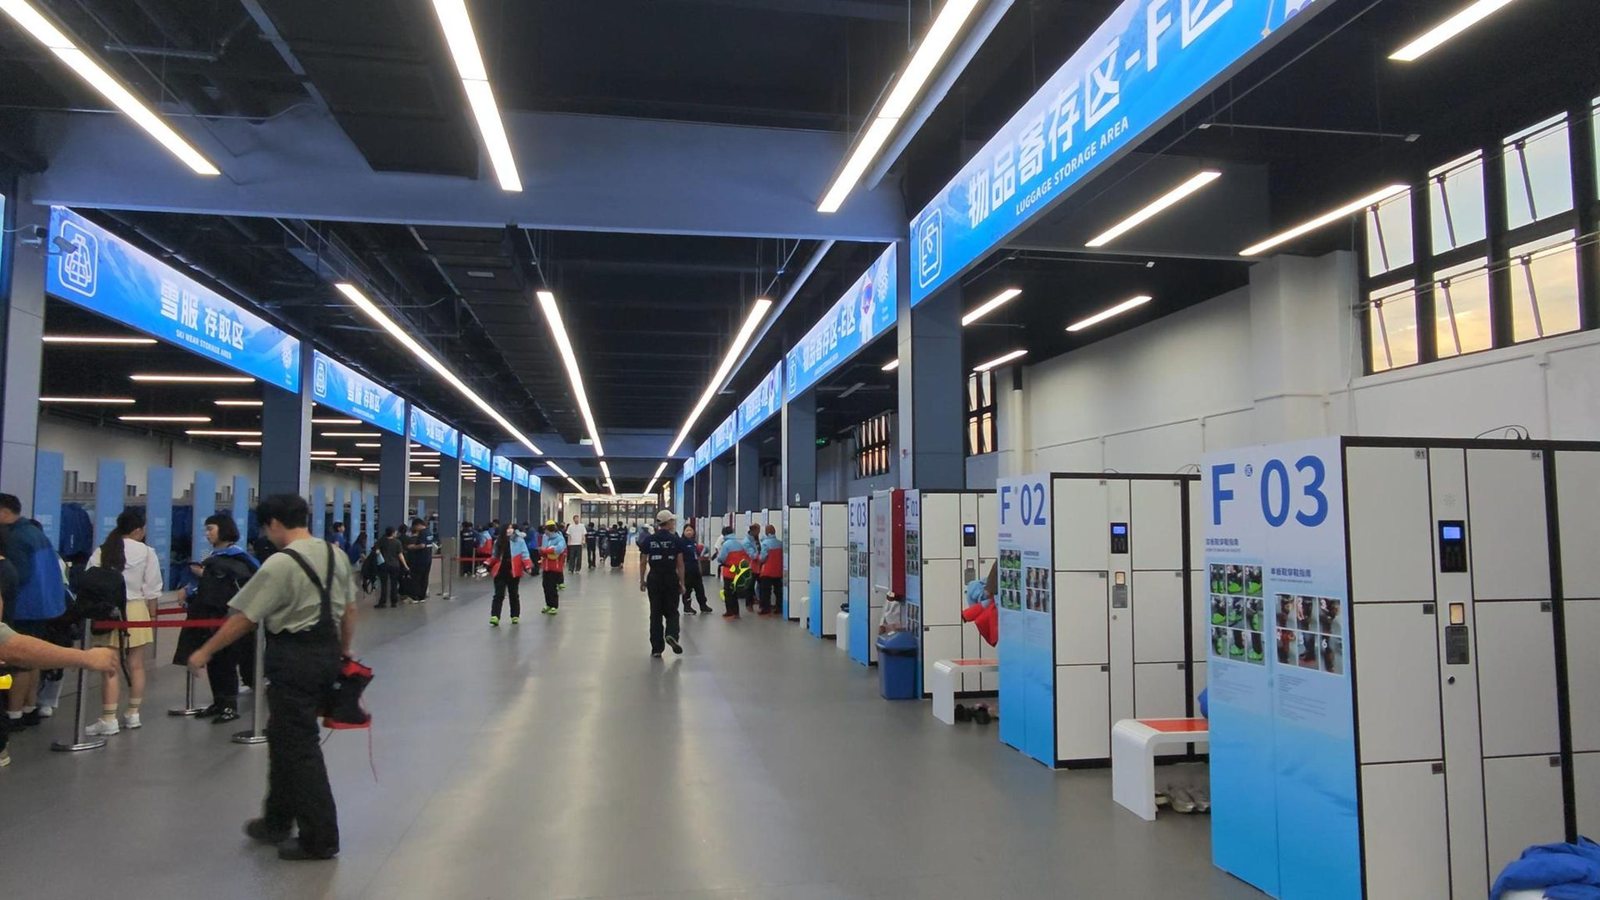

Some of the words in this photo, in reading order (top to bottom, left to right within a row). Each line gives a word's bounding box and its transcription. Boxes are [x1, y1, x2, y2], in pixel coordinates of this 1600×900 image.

[1016, 178, 1052, 216] LUGGAGE
[1054, 141, 1097, 185] STORAGE
[1100, 116, 1129, 149] AREA
[160, 280, 199, 331] 雪服
[204, 307, 244, 350] 存取区
[856, 502, 867, 527] 03
[1001, 486, 1011, 525] F
[1020, 482, 1046, 526] 02
[1212, 463, 1236, 525] F
[1260, 455, 1329, 528] 03
[1321, 638, 1328, 649] 6
